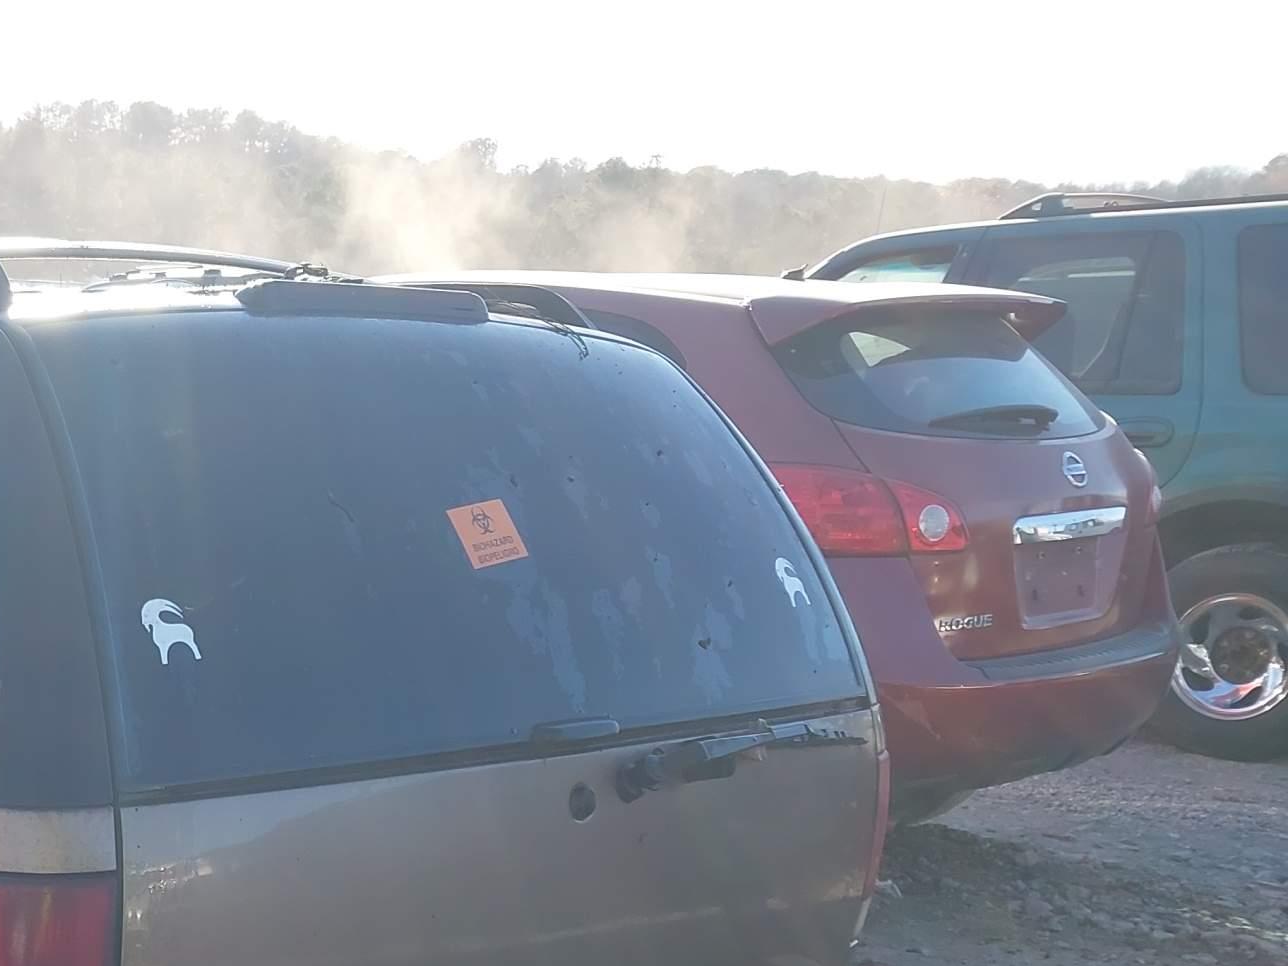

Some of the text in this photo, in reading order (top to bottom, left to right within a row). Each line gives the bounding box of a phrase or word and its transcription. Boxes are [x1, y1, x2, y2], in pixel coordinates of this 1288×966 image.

[472, 535, 515, 552] BIOHAZARD
[478, 547, 519, 563] BIOPELIGRO
[938, 614, 993, 633] ROGUE
